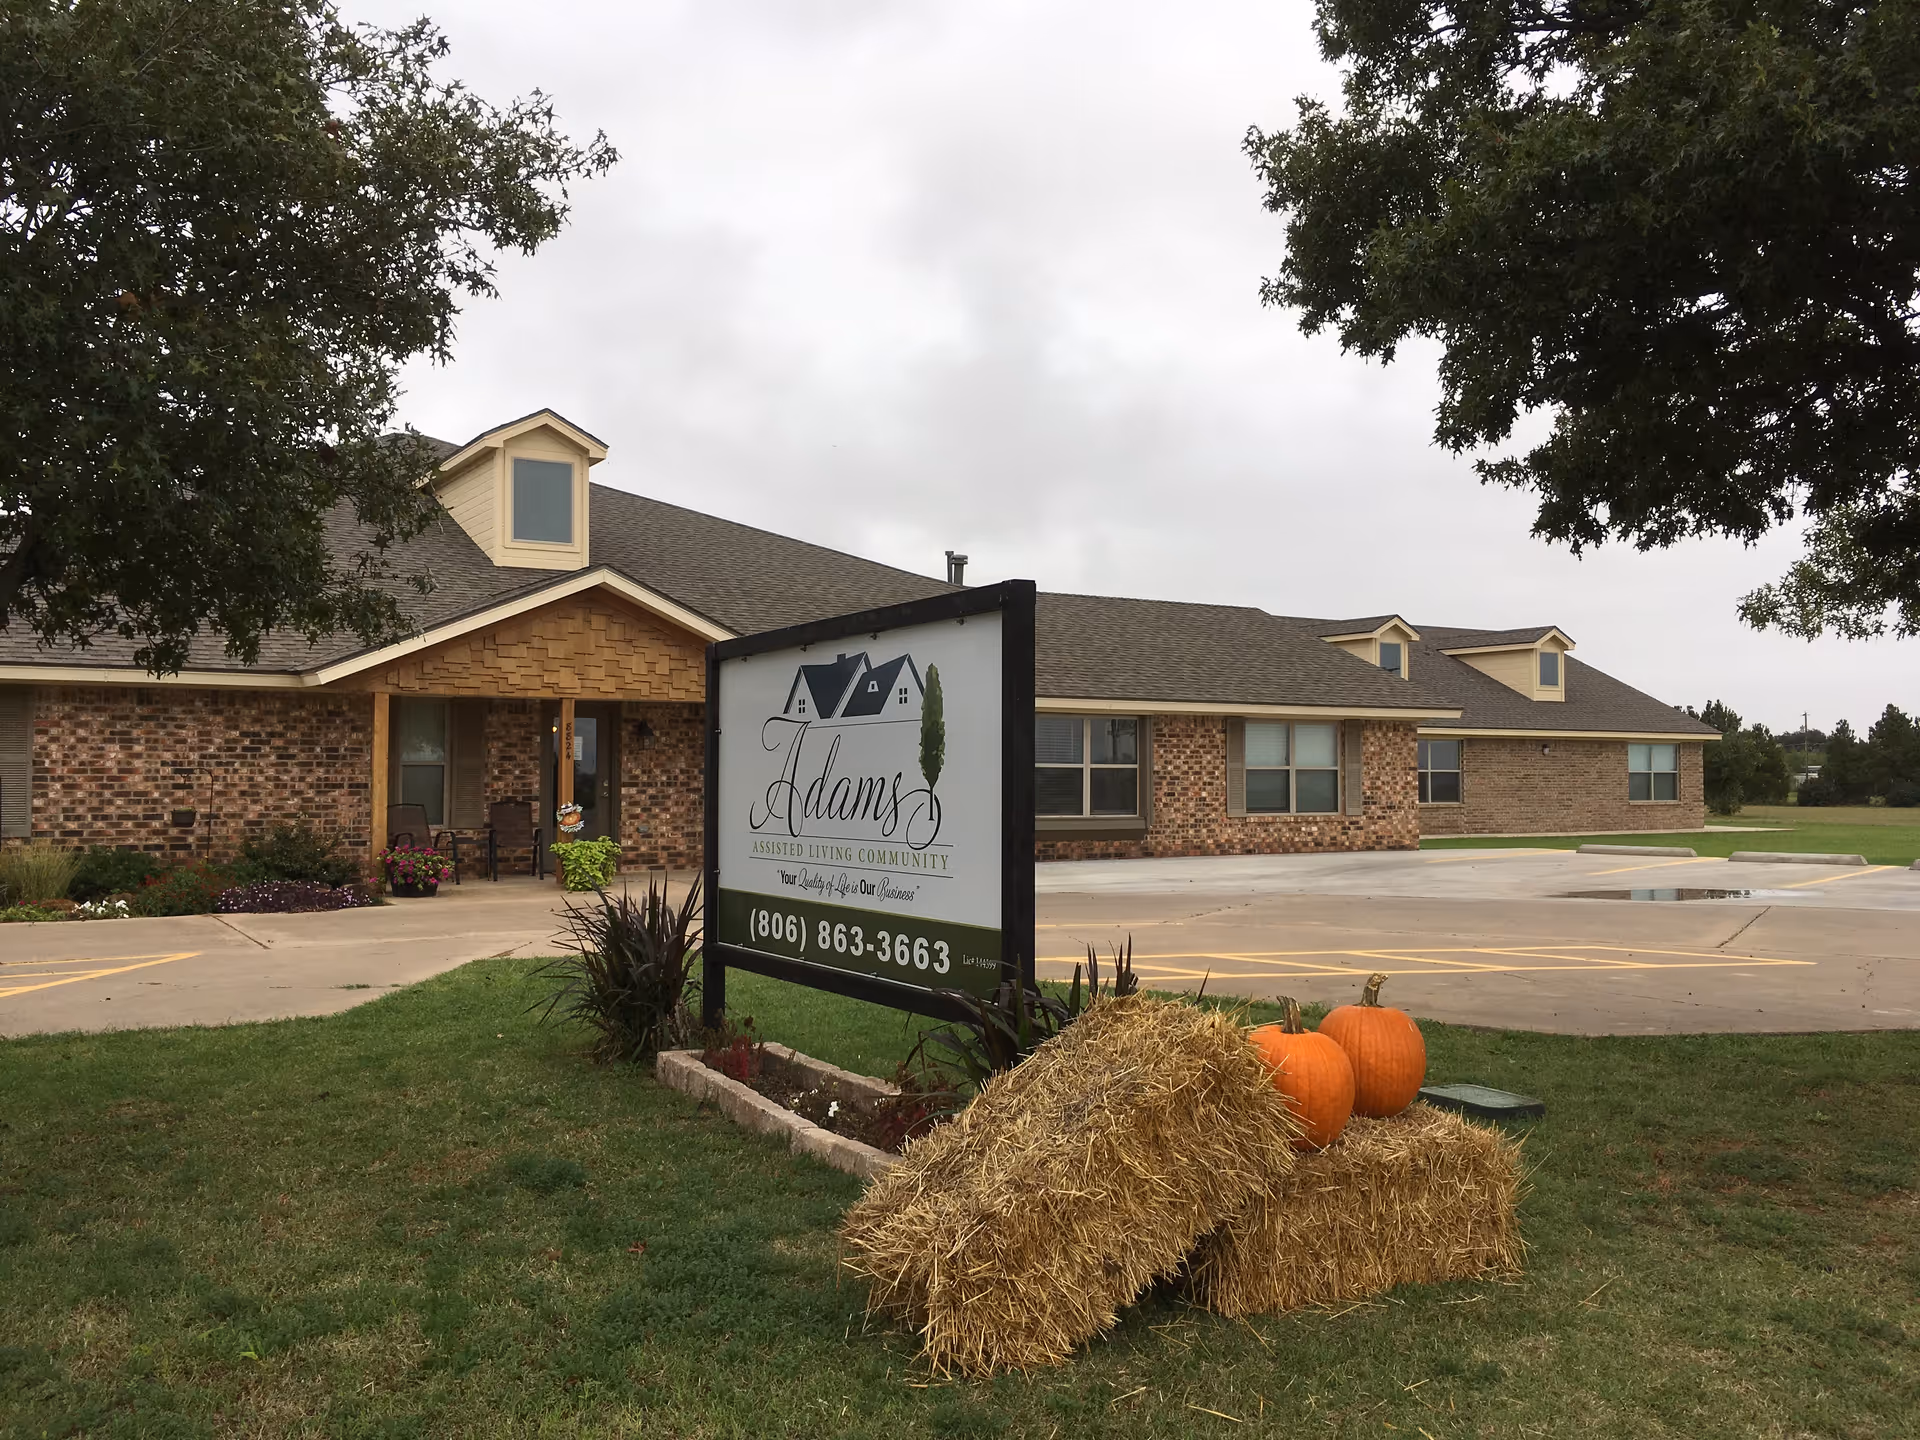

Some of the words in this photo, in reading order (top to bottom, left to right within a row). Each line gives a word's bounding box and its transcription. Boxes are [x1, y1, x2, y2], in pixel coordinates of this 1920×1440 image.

[750, 717, 942, 850] Adams
[752, 840, 804, 856] ASSISTED
[808, 844, 852, 861] LIVING
[858, 848, 949, 870] COMMUNITY
[798, 868, 825, 896] Quality
[825, 874, 835, 897] of
[834, 872, 850, 898] Life
[850, 881, 859, 894] is
[859, 879, 876, 896] Our
[750, 908, 807, 952] (806)
[817, 920, 950, 974] 863-3663
